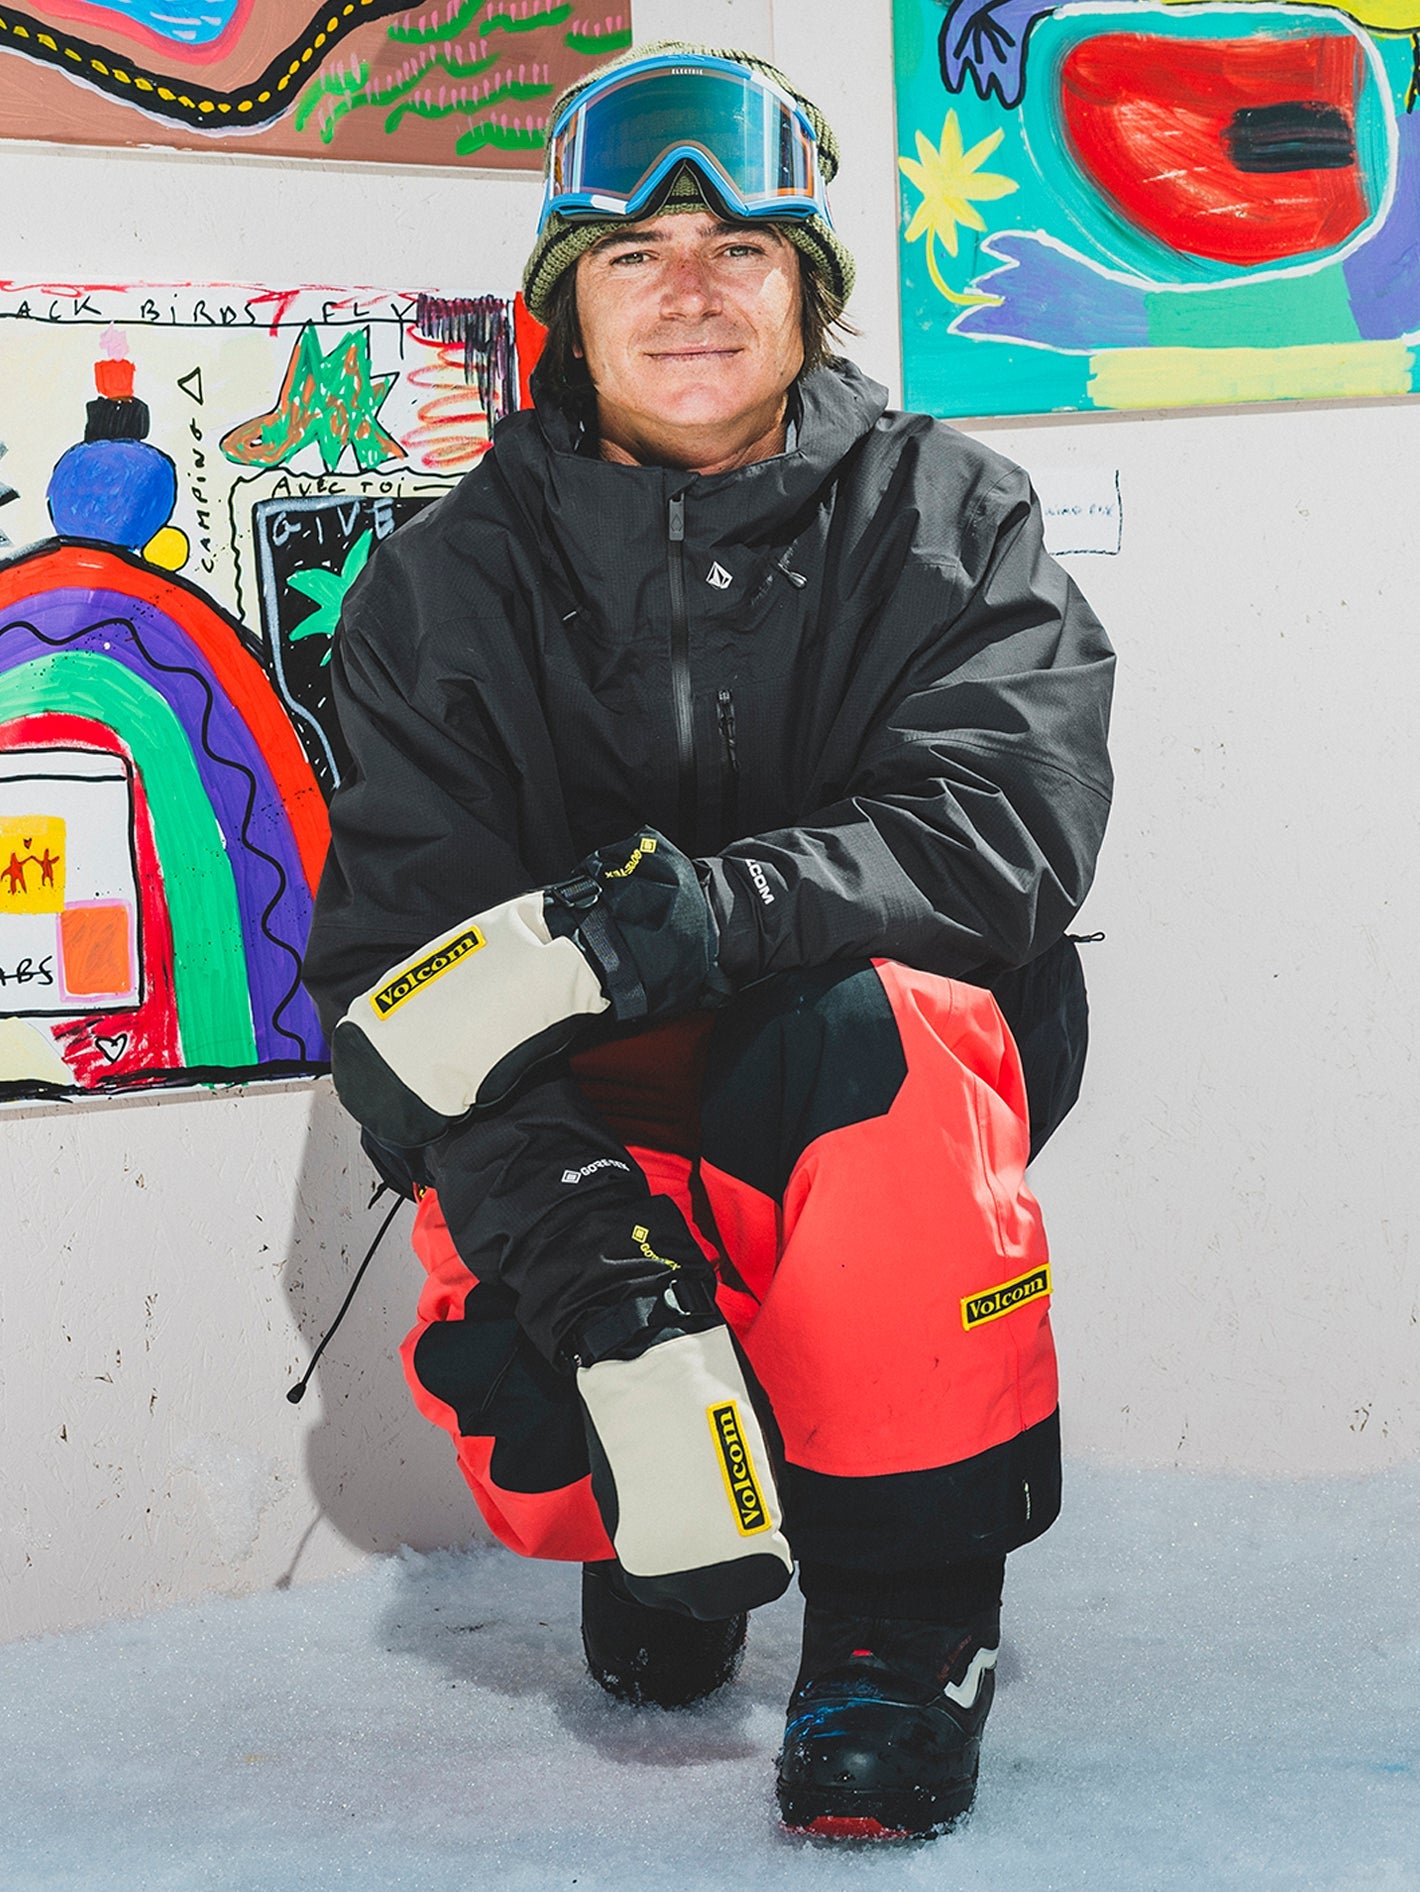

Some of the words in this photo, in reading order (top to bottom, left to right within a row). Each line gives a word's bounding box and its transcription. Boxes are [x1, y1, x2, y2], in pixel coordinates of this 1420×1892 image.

[671, 67, 704, 76] ELECTRIC
[322, 300, 418, 361] FLY
[271, 475, 346, 498] AVEC
[379, 936, 476, 1006] Volcom
[969, 1277, 1044, 1319] Volcom
[719, 1410, 761, 1526] Volcom
